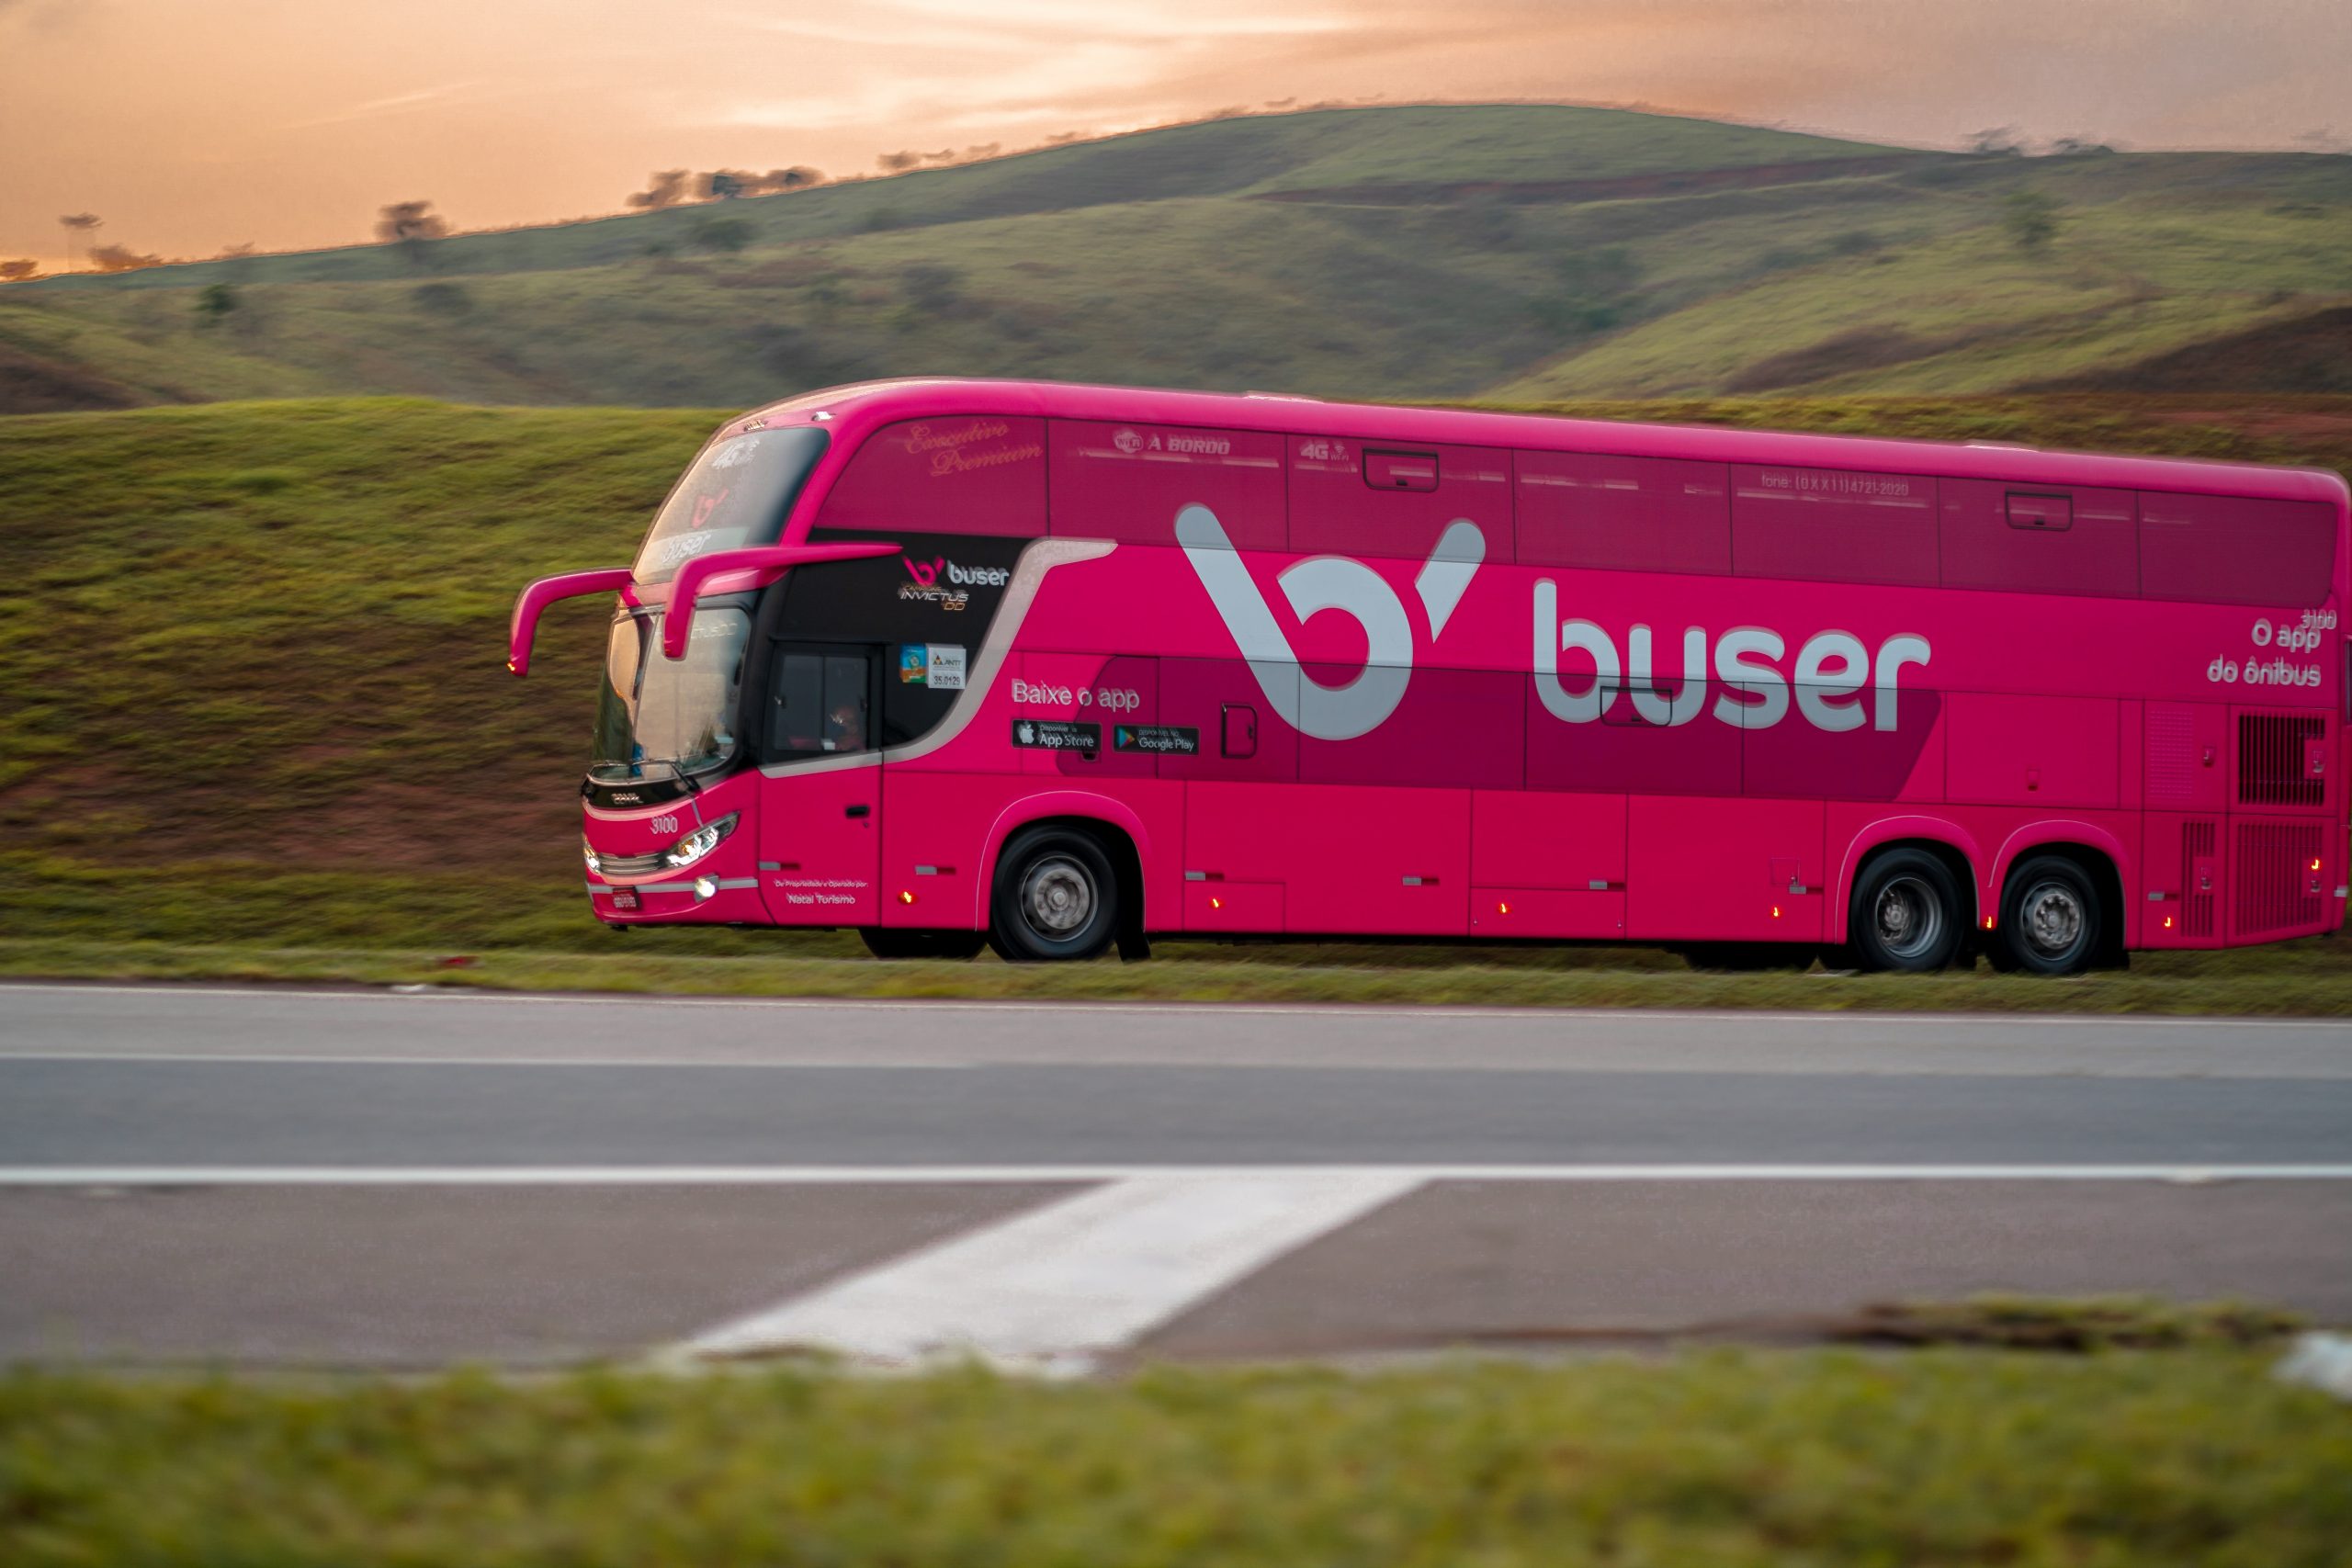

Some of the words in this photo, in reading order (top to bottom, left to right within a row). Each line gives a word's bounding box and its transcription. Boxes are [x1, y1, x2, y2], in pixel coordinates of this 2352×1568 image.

[1148, 434, 1161, 451] A
[1168, 434, 1230, 455] BORDO
[1300, 441, 1329, 460] 4G
[931, 443, 1043, 476] Premium
[947, 558, 1010, 586] buser
[899, 588, 970, 603] INVICTUS
[943, 602, 965, 611] DD
[2301, 608, 2337, 629] 3100
[2251, 617, 2273, 647] O
[2276, 625, 2322, 654] app
[1533, 578, 1932, 732] buser
[2207, 653, 2239, 683] do
[2243, 655, 2322, 687] ônibus
[1012, 679, 1073, 705] Baixe
[1077, 686, 1093, 706] o
[1098, 687, 1140, 713] app
[1039, 733, 1063, 748] App
[1064, 734, 1094, 748] Store
[1139, 736, 1173, 751] Google
[1174, 738, 1194, 752] Play
[650, 814, 678, 835] 3100
[787, 893, 814, 904] Natal
[815, 893, 856, 904] Turismo
